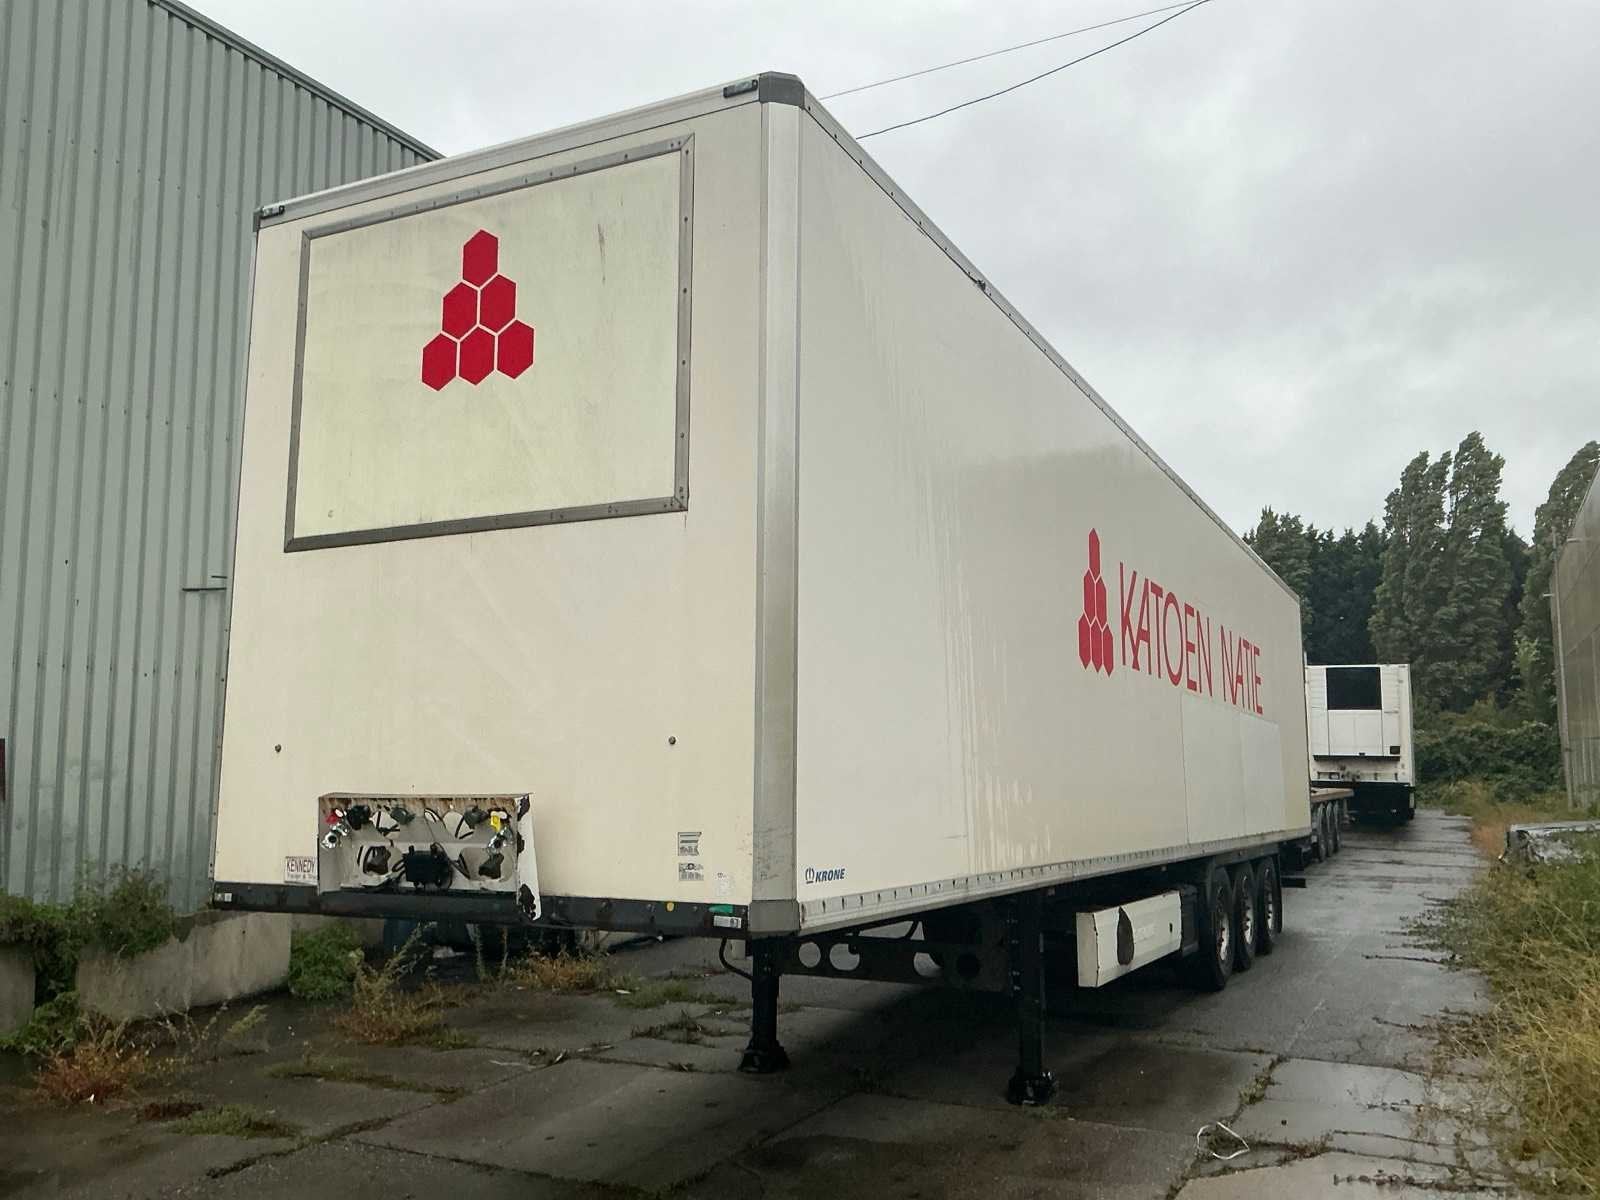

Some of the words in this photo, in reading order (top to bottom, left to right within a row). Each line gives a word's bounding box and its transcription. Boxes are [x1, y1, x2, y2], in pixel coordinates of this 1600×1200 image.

[1119, 561, 1213, 697] KATOEN
[1220, 624, 1264, 715] NATIE
[286, 858, 316, 873] KENNEDY
[815, 868, 846, 883] KRONE
